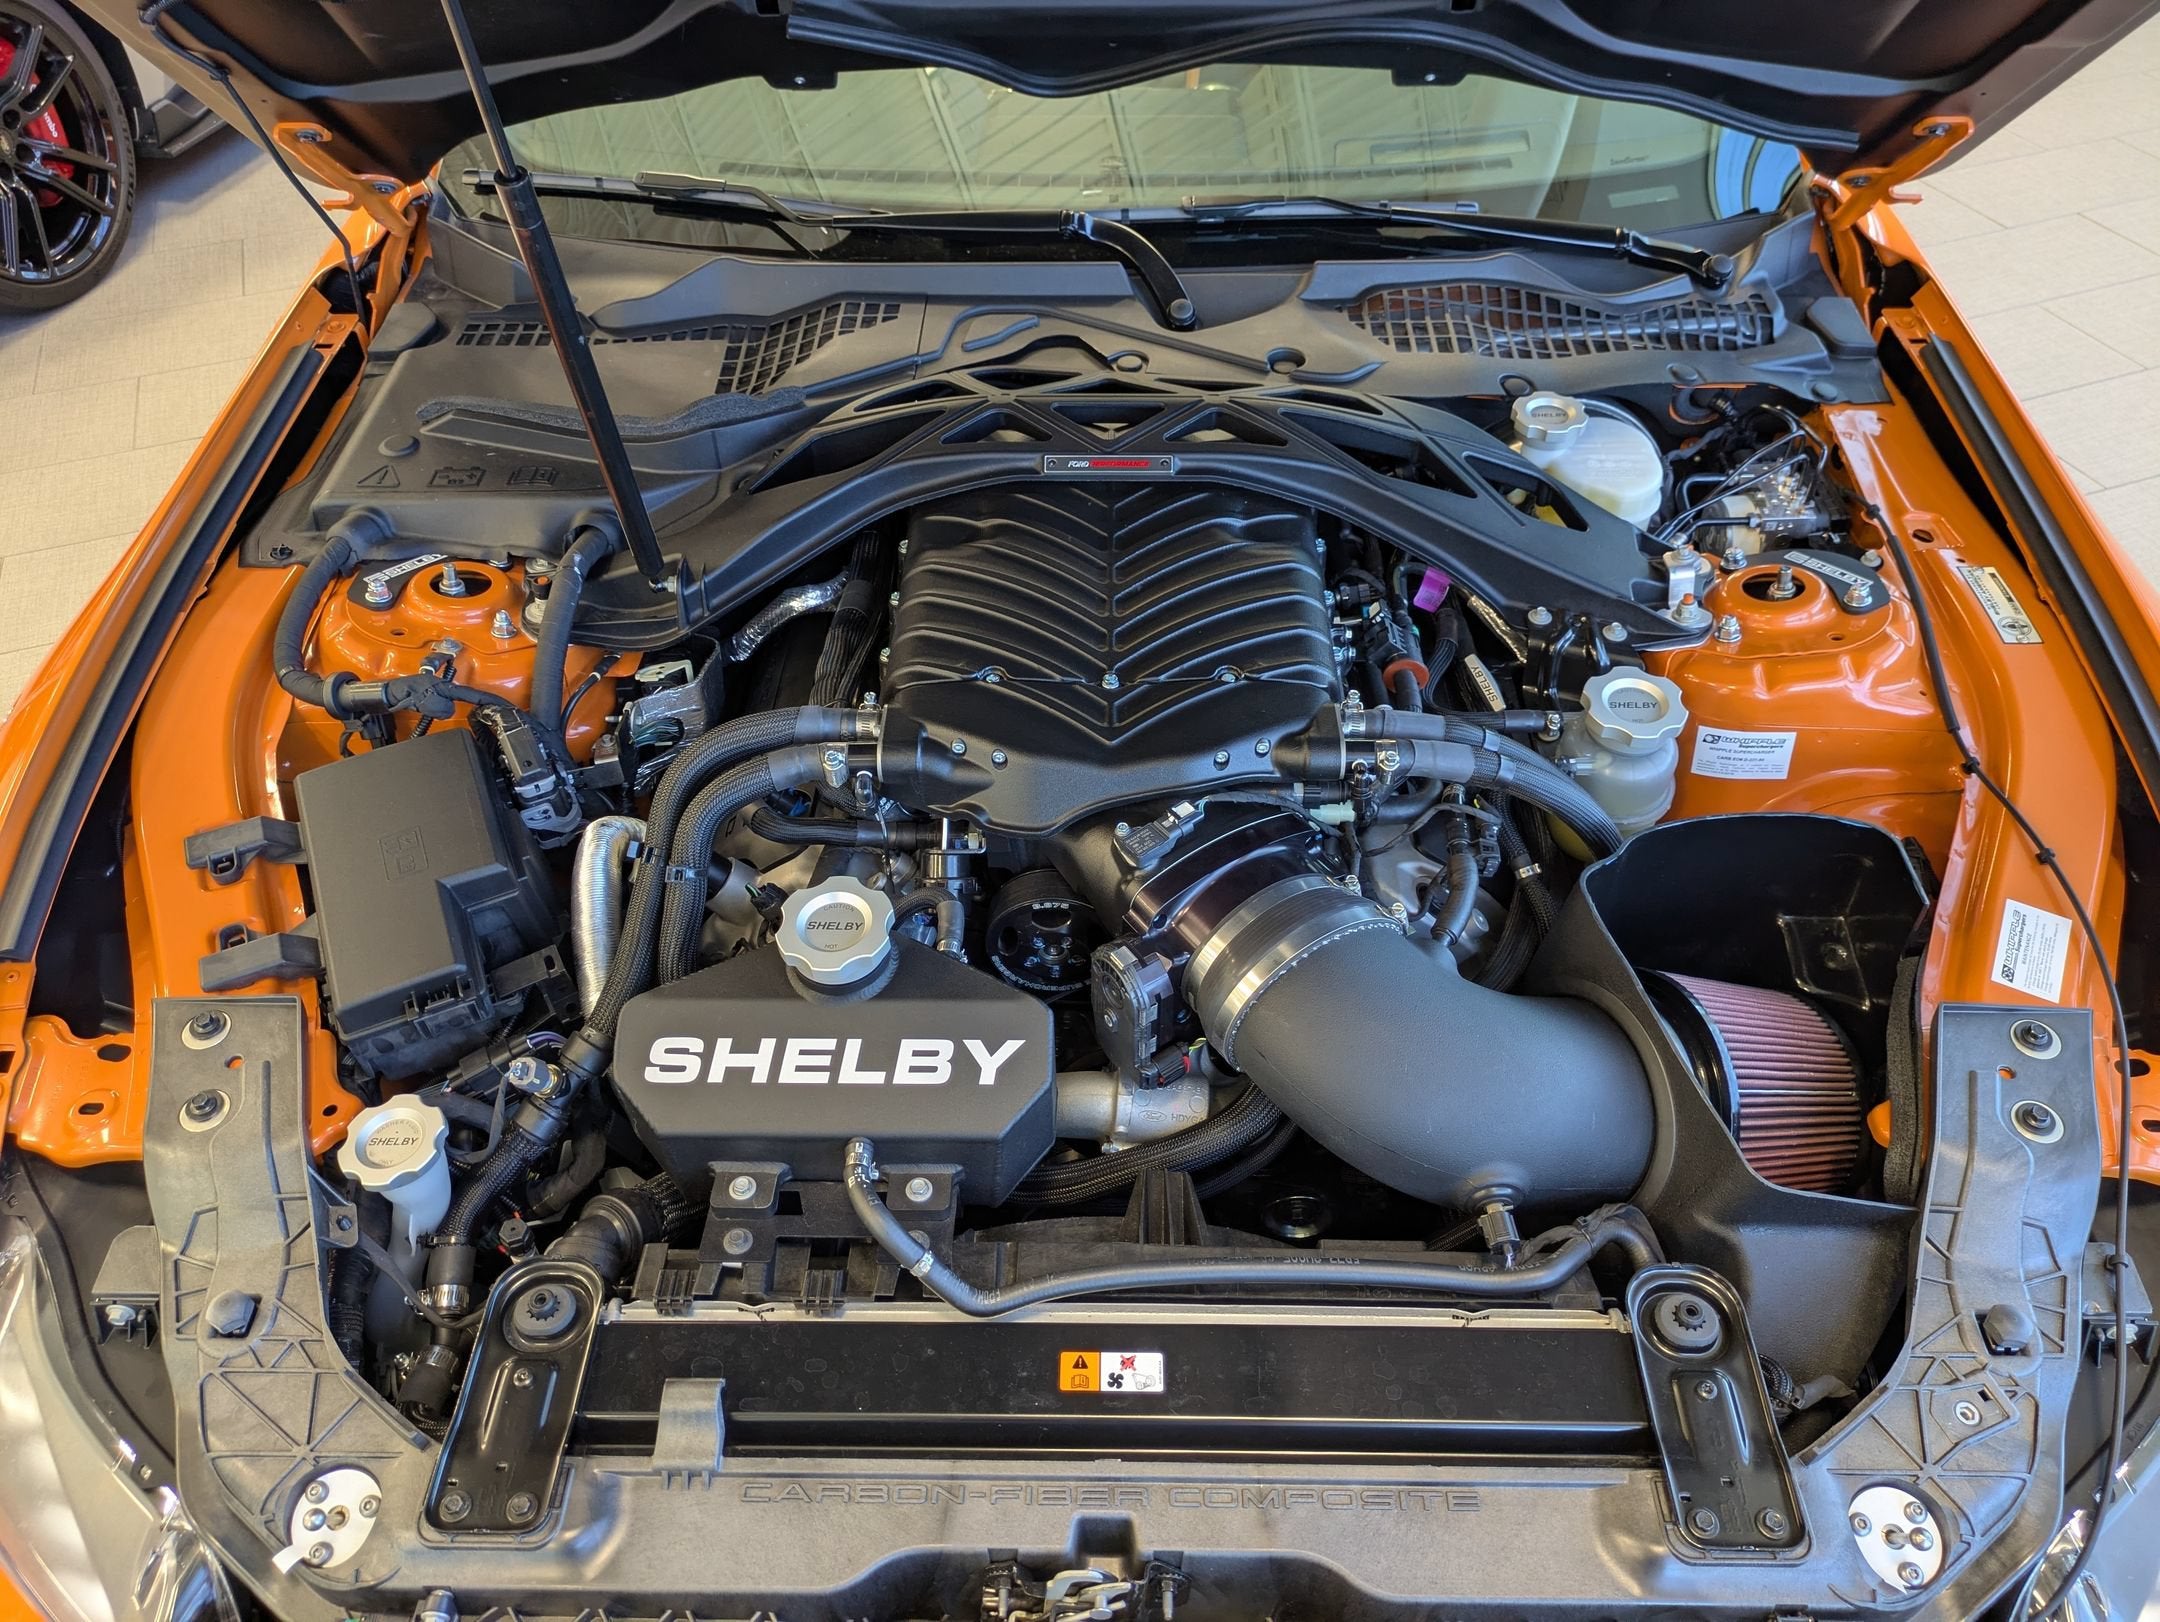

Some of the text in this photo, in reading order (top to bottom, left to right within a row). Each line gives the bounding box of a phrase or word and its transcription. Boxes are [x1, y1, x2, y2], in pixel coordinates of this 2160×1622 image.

[1067, 460, 1089, 468] FORD
[1471, 666, 1499, 702] SHELBY
[1609, 701, 1658, 709] SHELBY
[823, 904, 855, 912] CAUTION
[807, 921, 863, 930] SHELBY
[2004, 909, 2021, 966] WHIPPLE
[644, 1036, 1027, 1086] SHELBY
[368, 1137, 419, 1146] SHELBY
[740, 1483, 1482, 1512] CARBON-FIBER COMPOSITE
